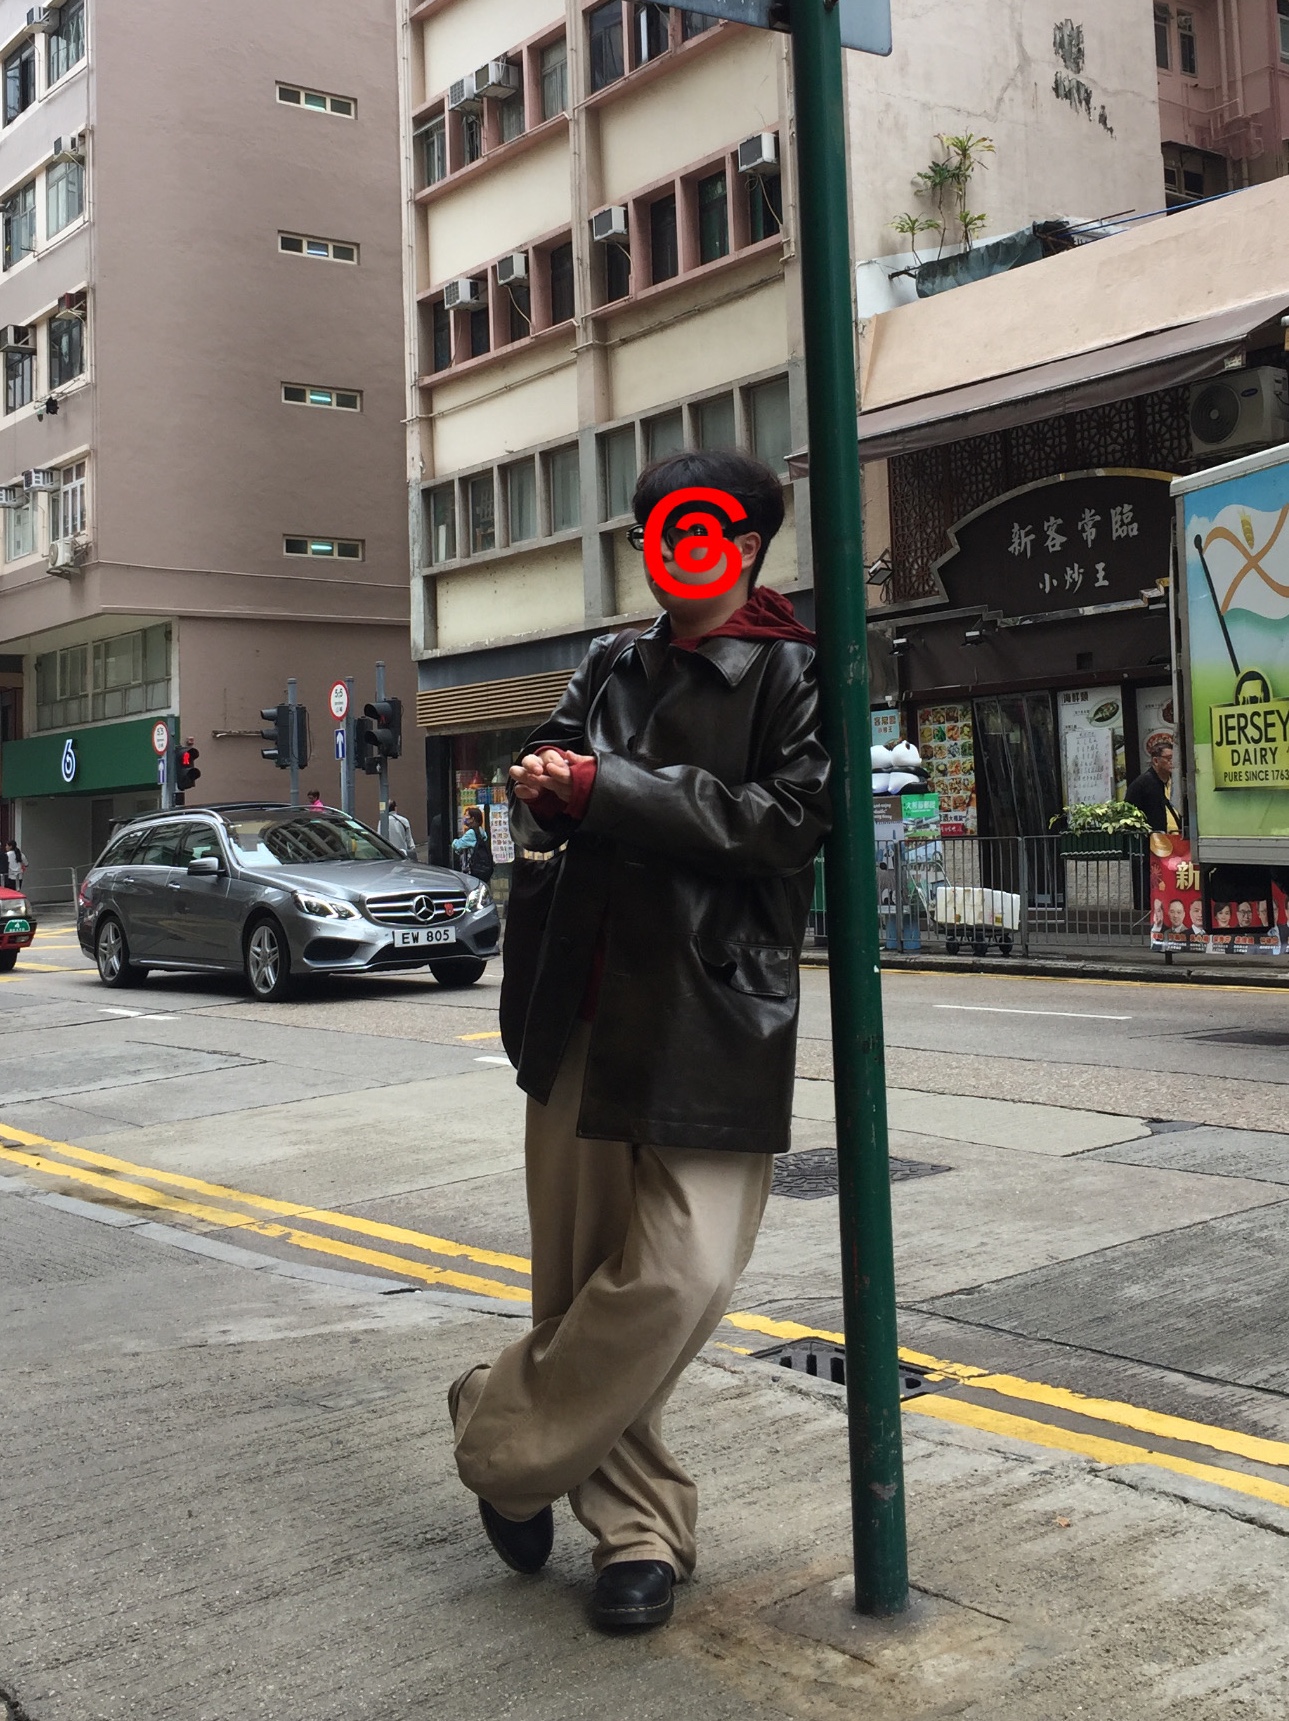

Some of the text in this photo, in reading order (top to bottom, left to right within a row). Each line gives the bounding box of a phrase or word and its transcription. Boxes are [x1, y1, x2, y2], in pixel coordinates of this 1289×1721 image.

[1007, 503, 1139, 559] 新客常臨
[1038, 562, 1110, 594] 小炒王
[1215, 709, 1289, 747] JERSEY
[1231, 746, 1278, 767] DAIRY
[1223, 769, 1289, 782] PURE SINCE 1763
[1176, 861, 1200, 891] 新
[402, 929, 450, 944] EW 805
